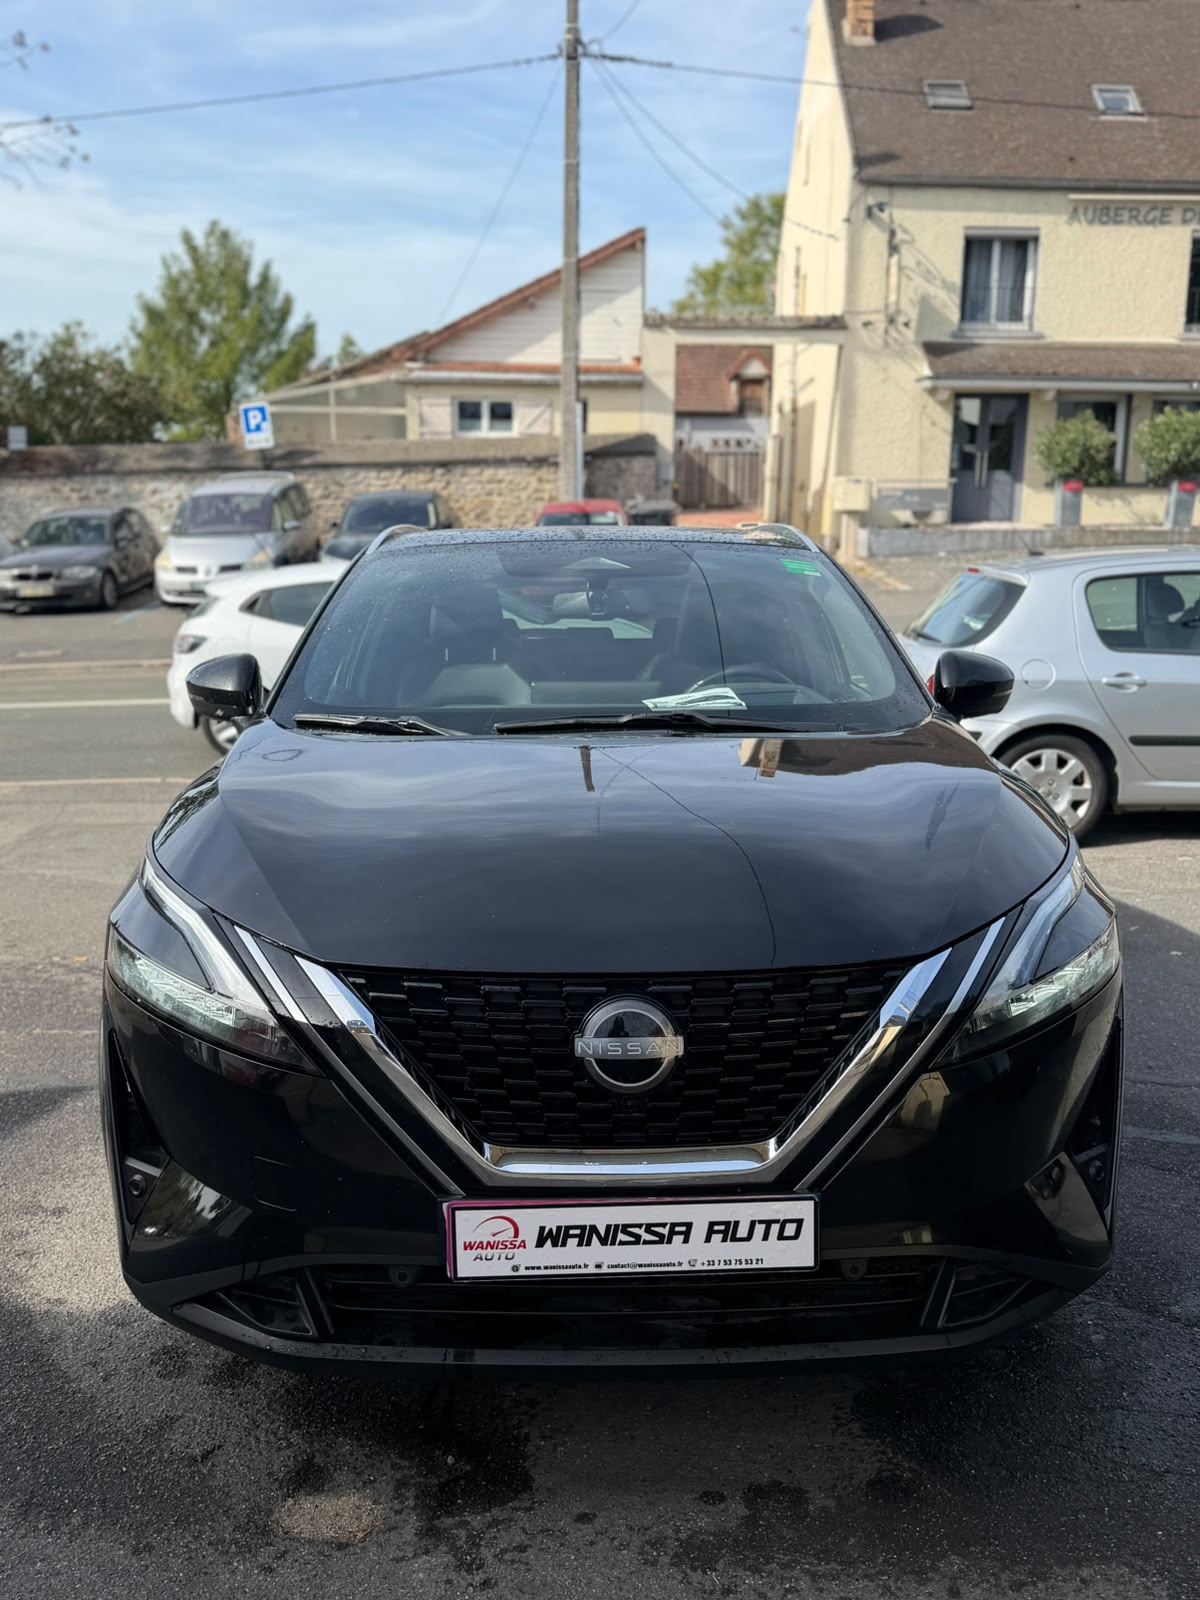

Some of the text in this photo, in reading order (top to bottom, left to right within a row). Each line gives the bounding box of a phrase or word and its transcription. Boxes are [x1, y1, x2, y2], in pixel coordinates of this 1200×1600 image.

[1069, 206, 1173, 226] AUBERGE
[248, 410, 262, 430] P
[578, 1041, 680, 1055] NISSAN
[535, 1218, 805, 1248] WANISSA AUTO
[463, 1240, 527, 1251] WANISSA
[473, 1252, 515, 1261] AUTO
[524, 1263, 590, 1271] www.wanissaauto.fr
[607, 1261, 684, 1270] contact@wanissaauto.fr
